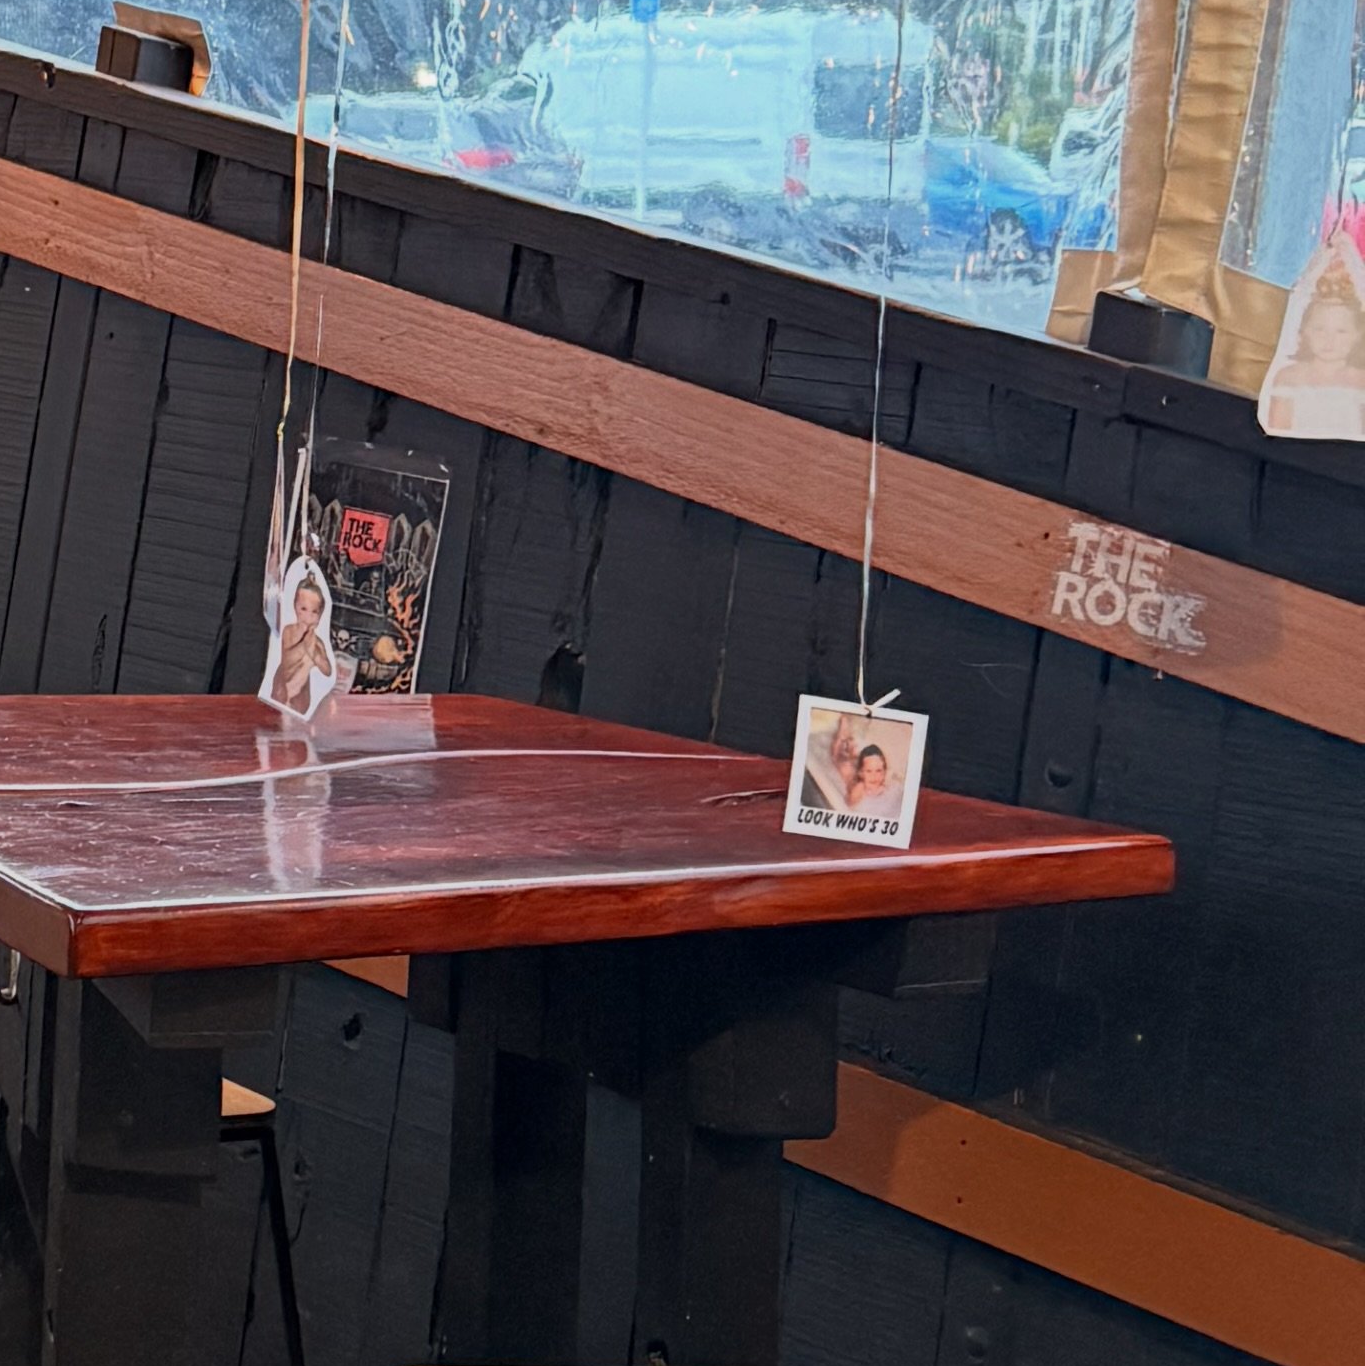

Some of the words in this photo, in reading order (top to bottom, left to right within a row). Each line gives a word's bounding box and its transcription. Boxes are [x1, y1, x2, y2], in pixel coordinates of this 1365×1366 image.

[349, 517, 375, 536] THE
[342, 531, 383, 554] ROCK
[1068, 522, 1168, 590] THE
[1051, 571, 1207, 648] ROCK
[797, 808, 833, 827] LOOK
[836, 814, 879, 833] WHO'S
[881, 820, 899, 835] 30
